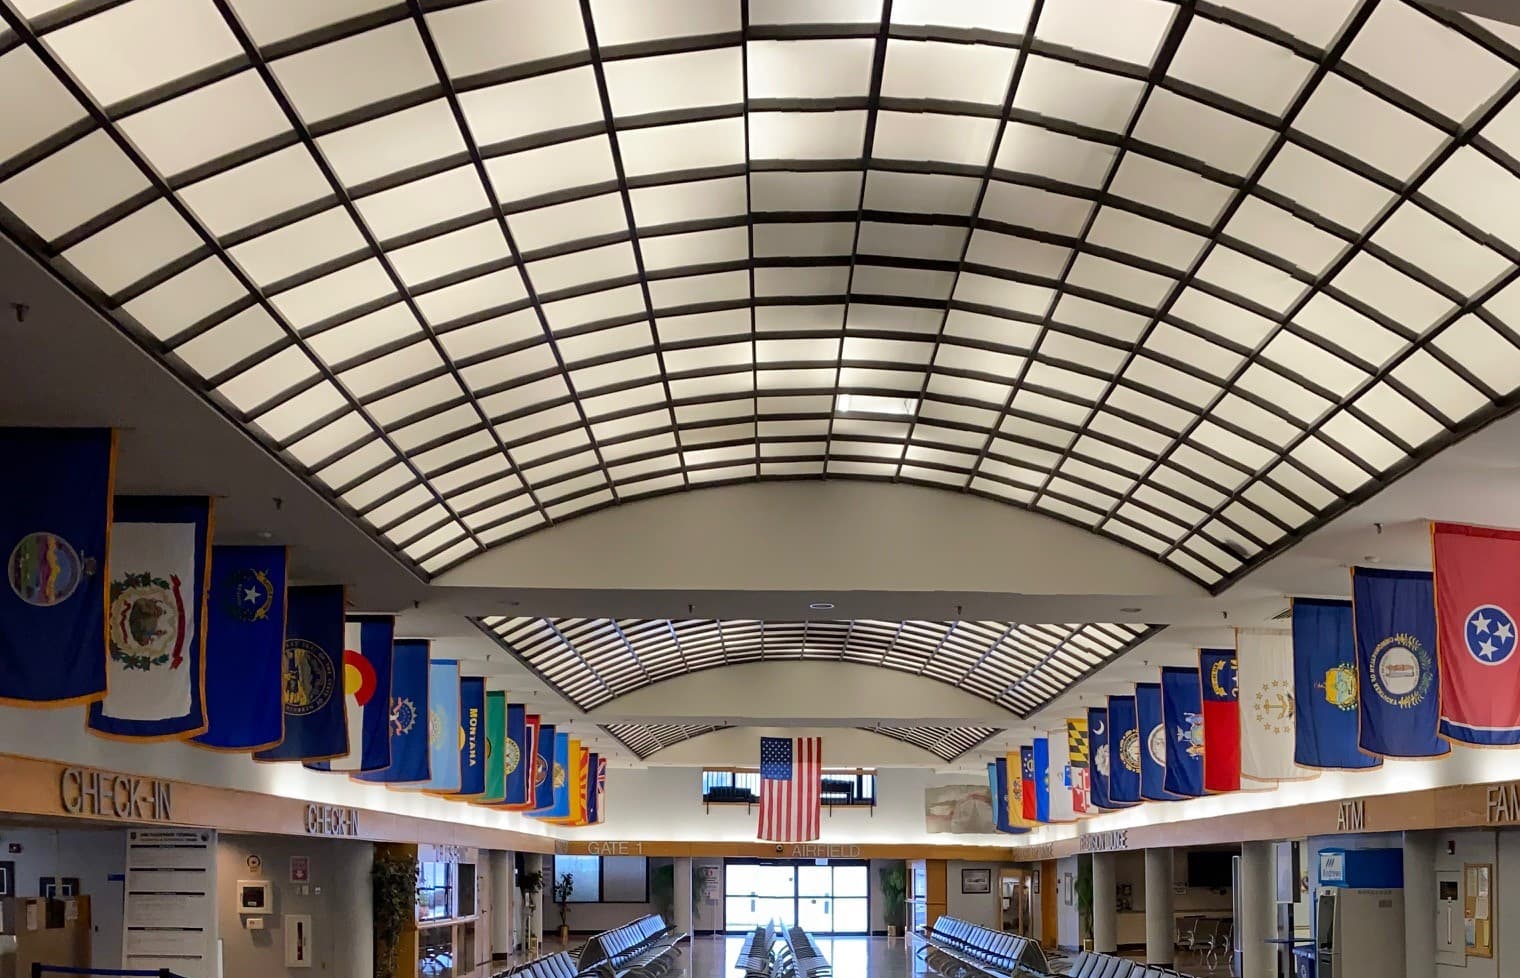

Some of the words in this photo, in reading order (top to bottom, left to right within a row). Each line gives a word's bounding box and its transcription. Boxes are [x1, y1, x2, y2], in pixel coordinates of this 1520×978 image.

[469, 708, 479, 767] MONTANA
[60, 766, 174, 821] CHECK-IN
[306, 804, 360, 837] CHECK-IN
[1336, 799, 1366, 832] ATM
[588, 841, 630, 855] GATE
[636, 841, 643, 855] 1
[791, 844, 861, 858] AIRFIELD
